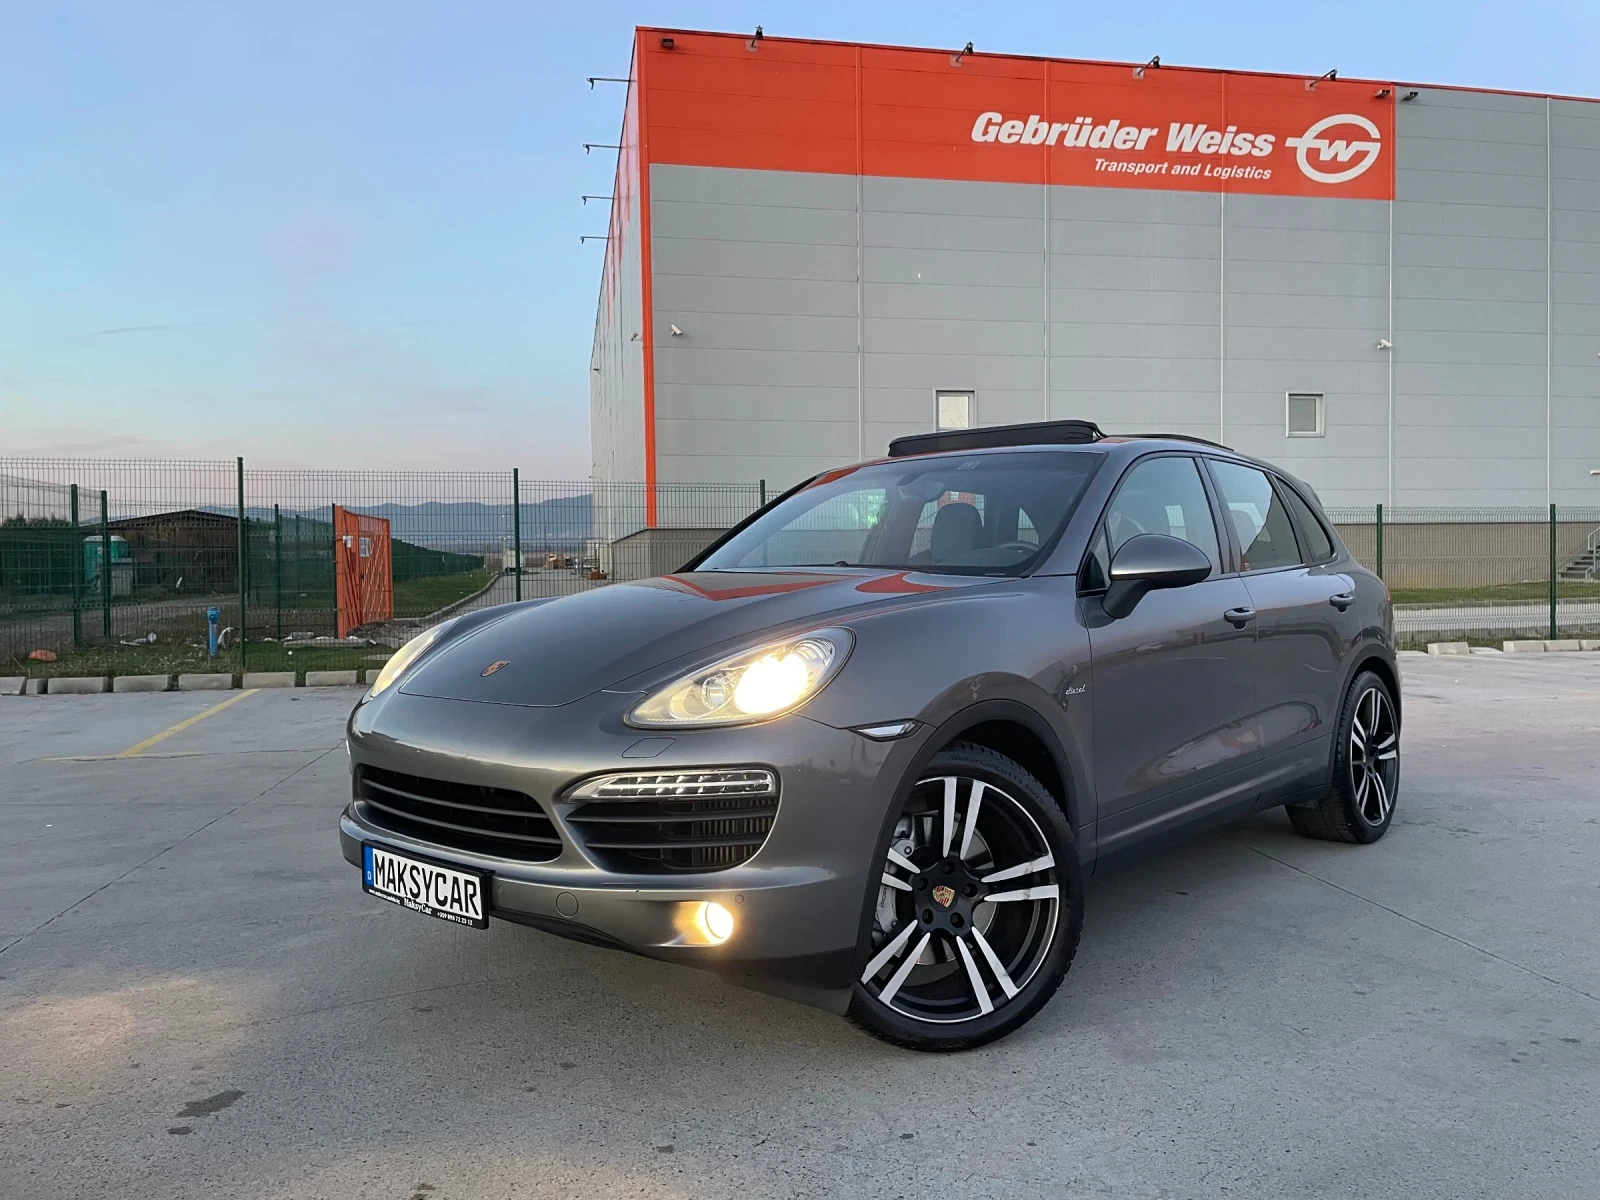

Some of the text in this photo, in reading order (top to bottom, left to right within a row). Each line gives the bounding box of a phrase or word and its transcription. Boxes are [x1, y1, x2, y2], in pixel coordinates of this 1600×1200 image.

[971, 111, 1275, 157] Gebrüder Weiss
[1094, 158, 1272, 180] Transport and Logistics
[367, 870, 372, 880] D
[374, 853, 480, 916] MAKSYCAR
[403, 897, 432, 915] MaksyCar
